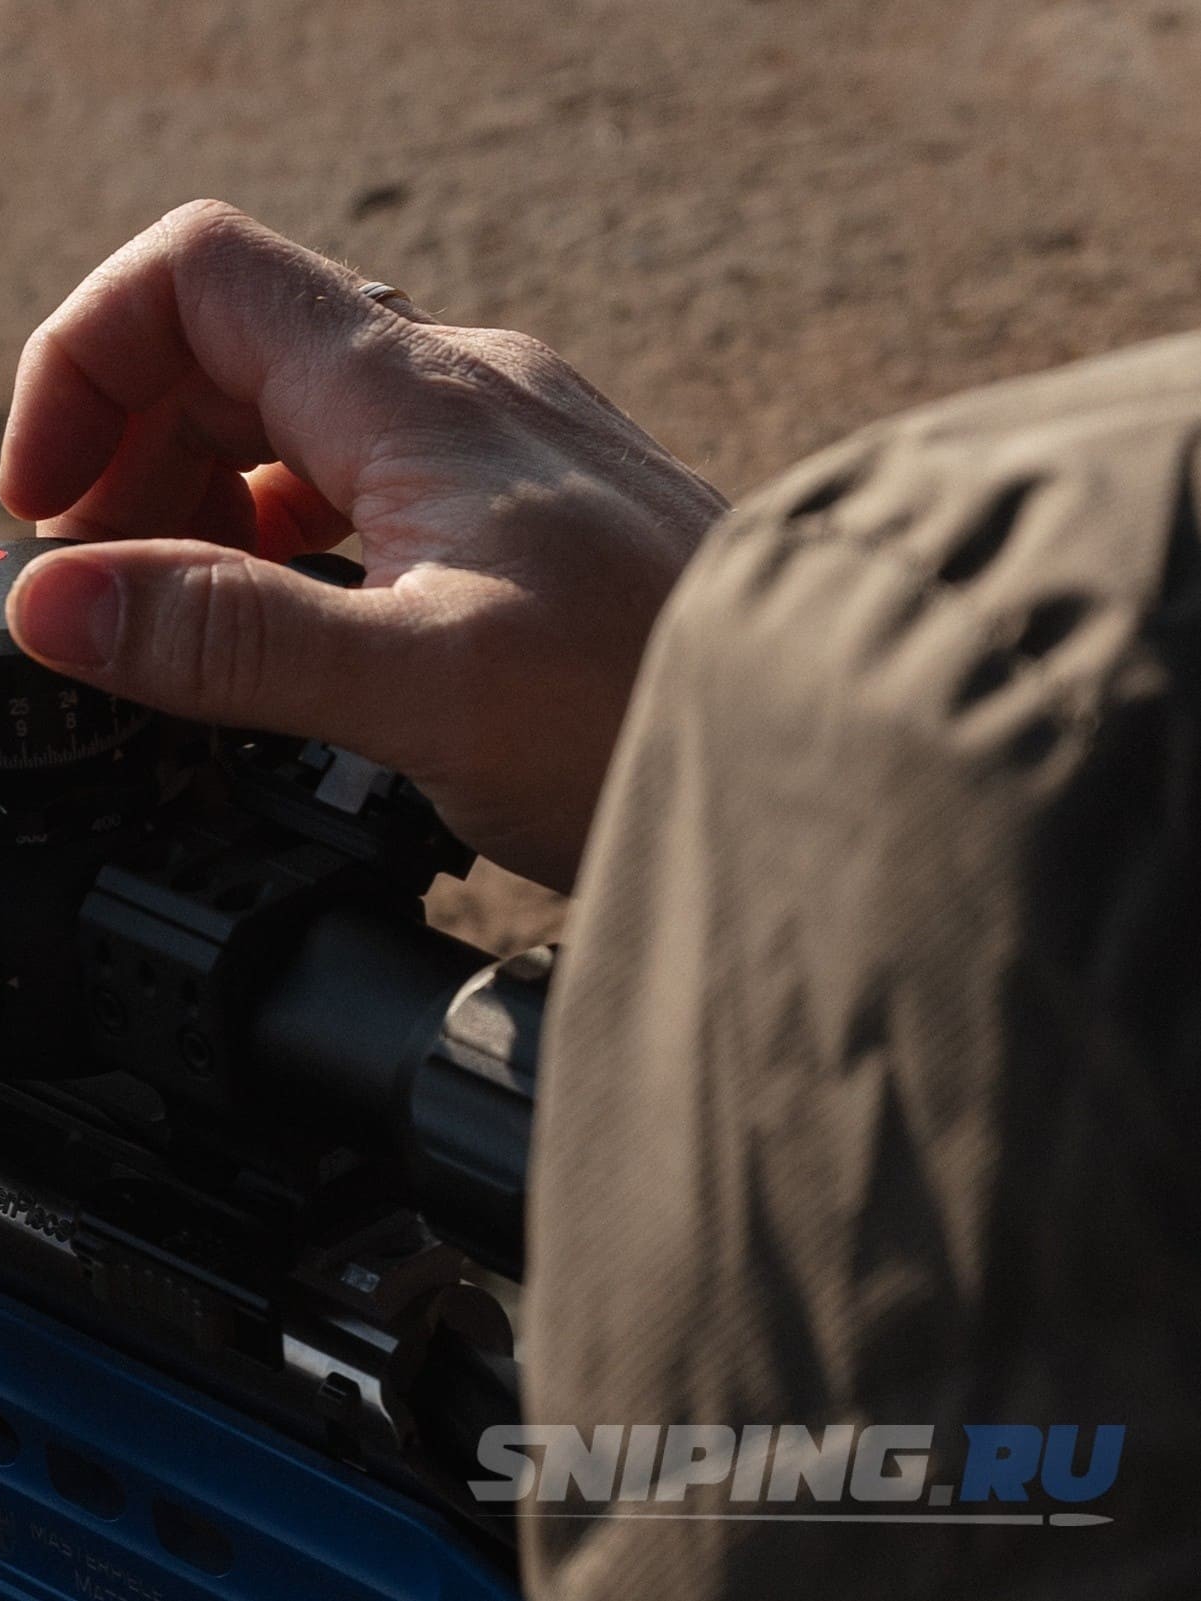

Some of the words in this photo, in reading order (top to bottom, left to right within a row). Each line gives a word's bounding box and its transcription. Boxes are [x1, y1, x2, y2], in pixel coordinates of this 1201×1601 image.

[8, 698, 30, 716] 25
[15, 719, 29, 737] 9
[65, 711, 79, 729] 8
